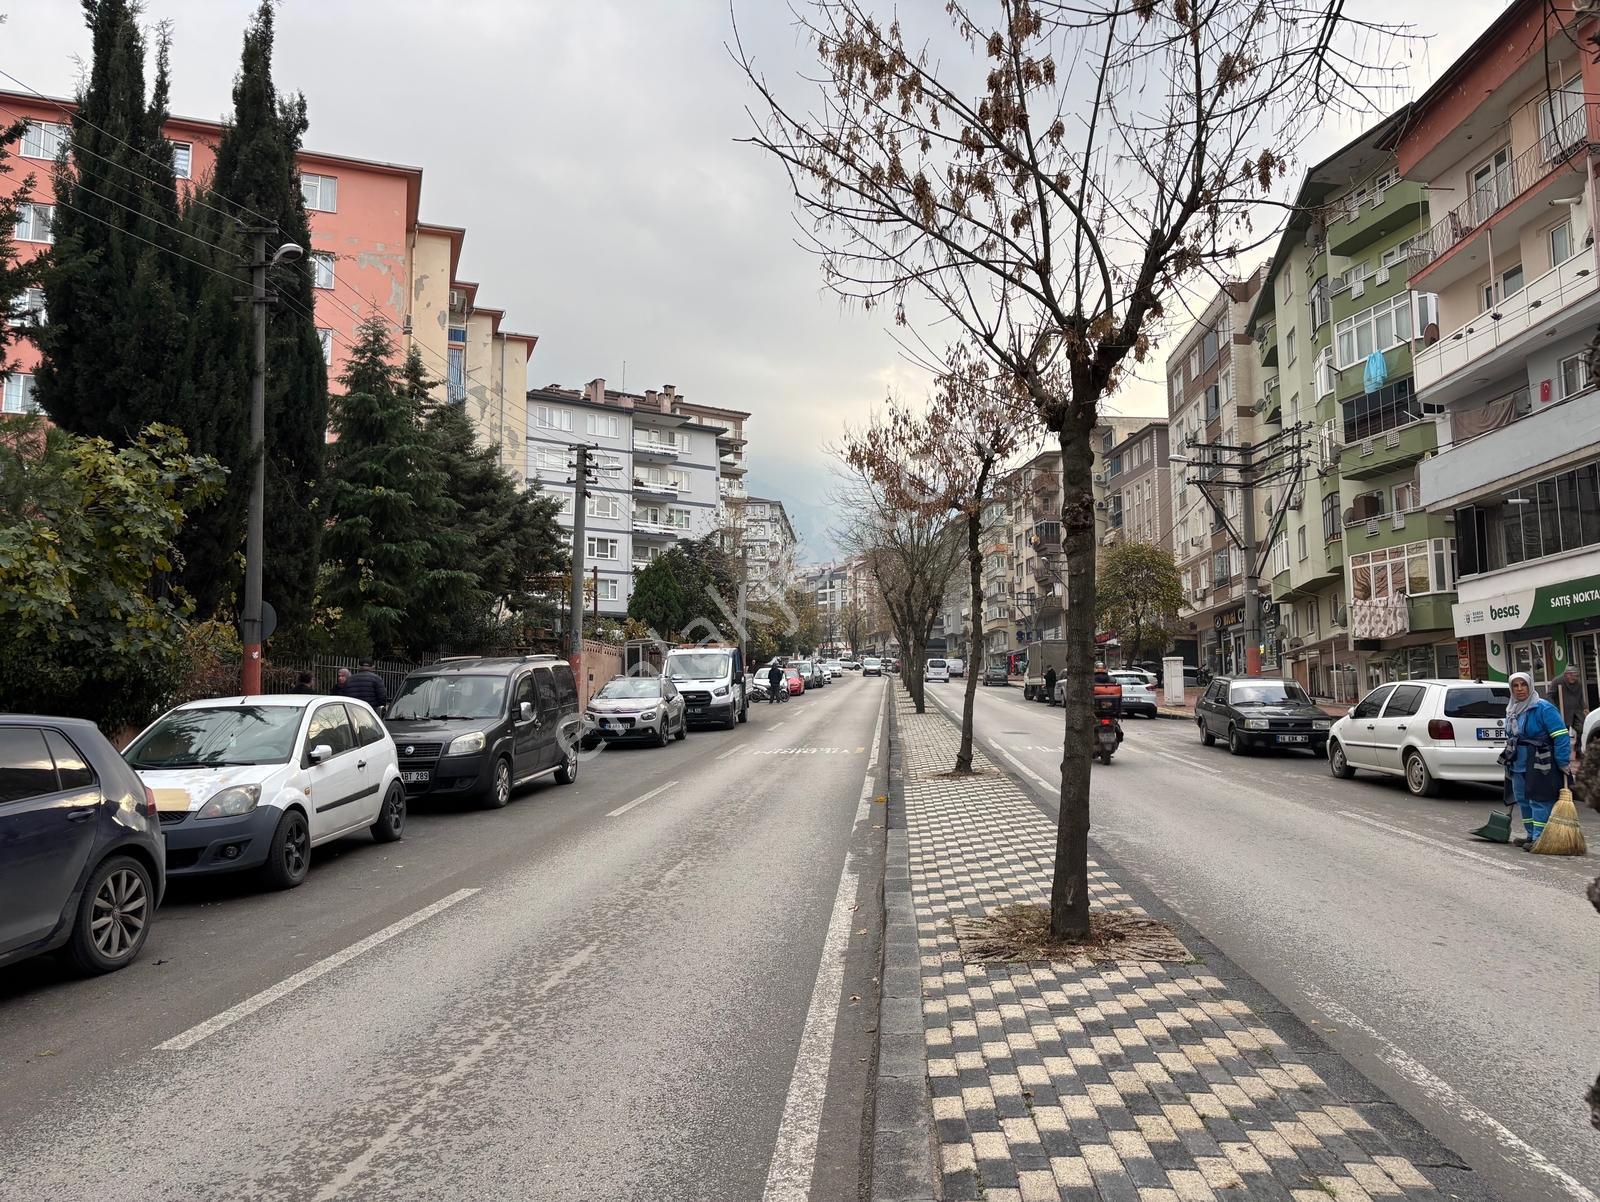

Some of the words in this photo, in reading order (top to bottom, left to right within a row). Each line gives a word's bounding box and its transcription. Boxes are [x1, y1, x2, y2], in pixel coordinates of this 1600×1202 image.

[1550, 595, 1571, 608] SATIŞ
[1572, 589, 1600, 604] NOKTA
[1489, 604, 1520, 621] besaş
